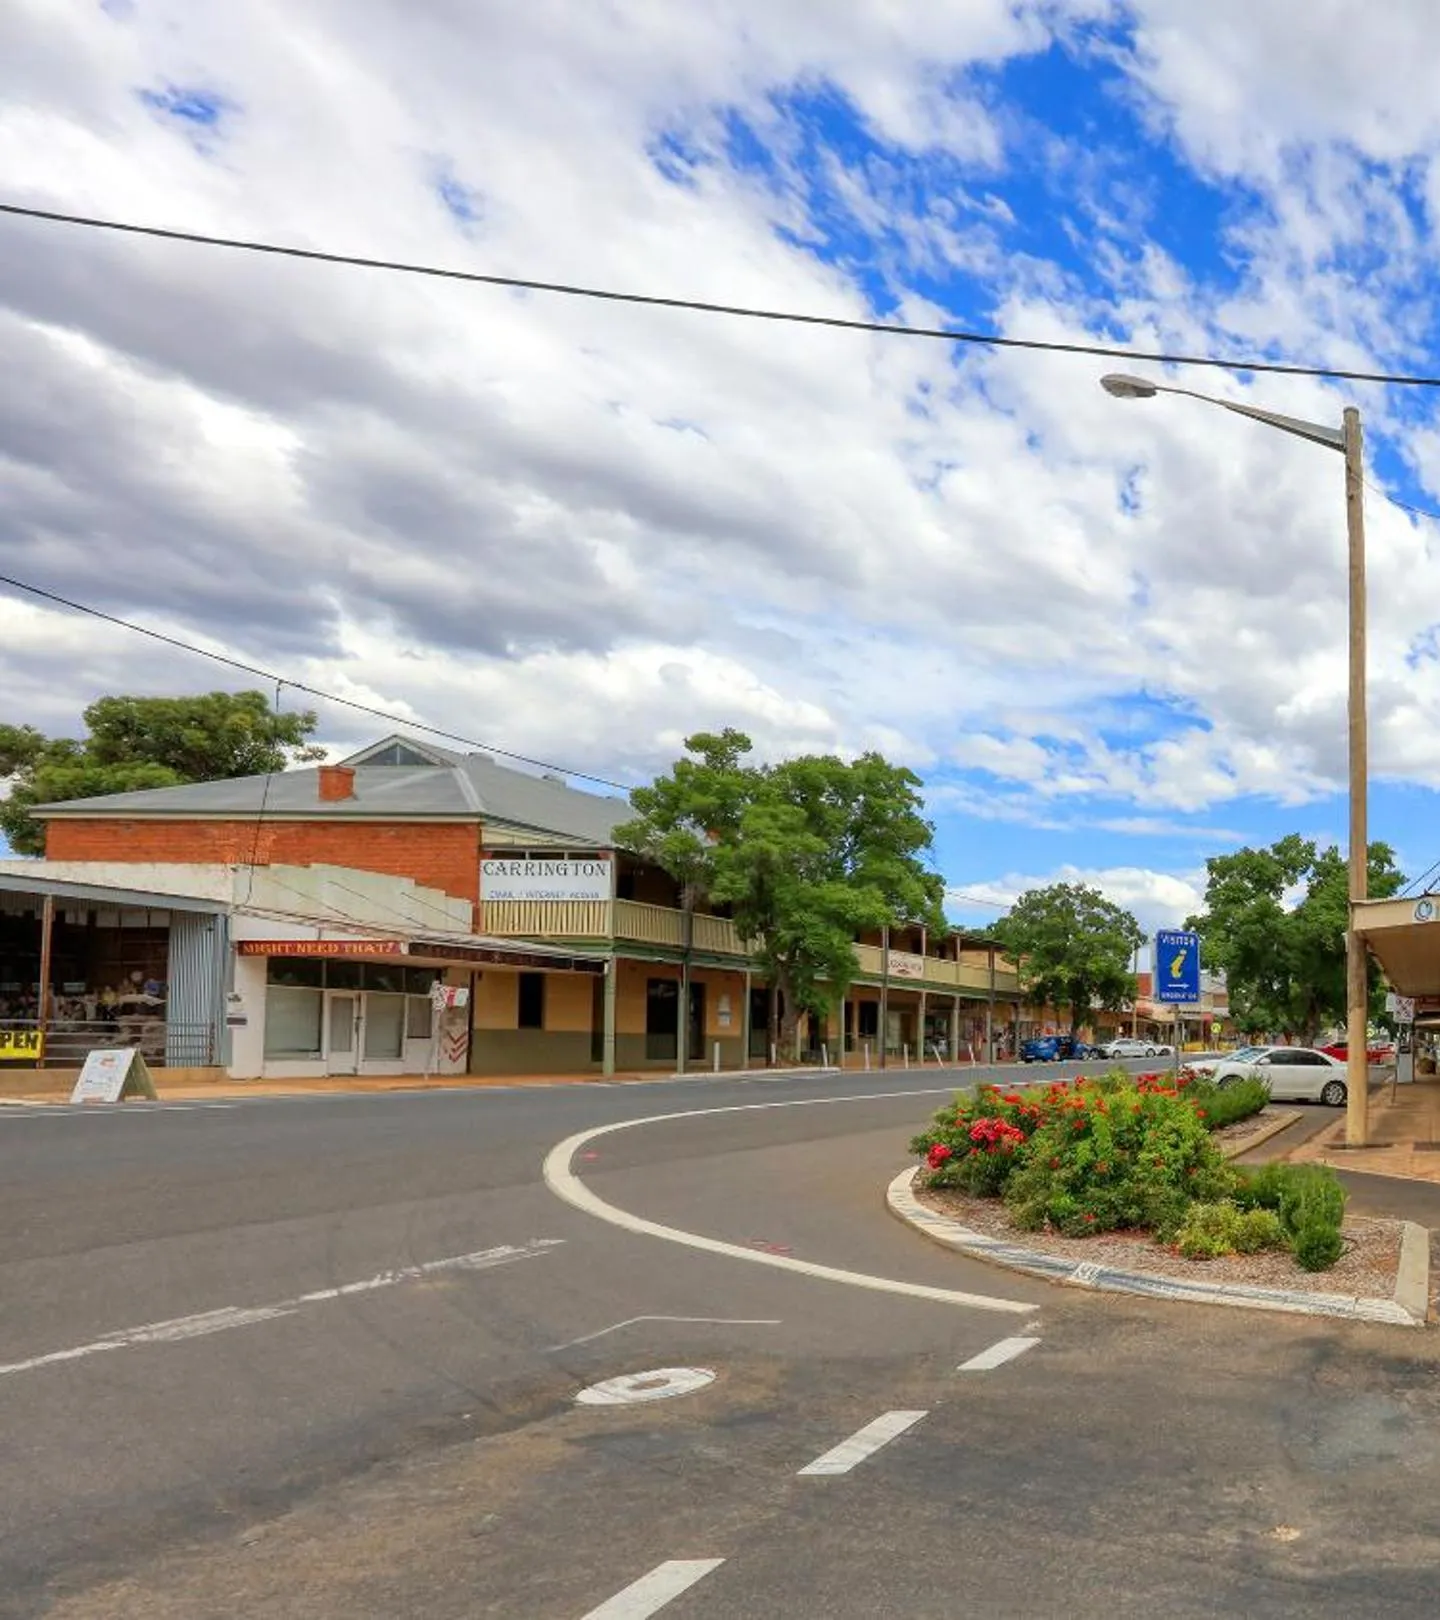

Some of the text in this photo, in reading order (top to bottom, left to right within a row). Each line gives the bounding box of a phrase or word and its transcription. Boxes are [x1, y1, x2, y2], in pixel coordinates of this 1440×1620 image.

[483, 861, 606, 877] CARRINGTON
[243, 943, 294, 954] MIGHT
[296, 943, 339, 954] NEED
[0, 1032, 39, 1050] PEN
